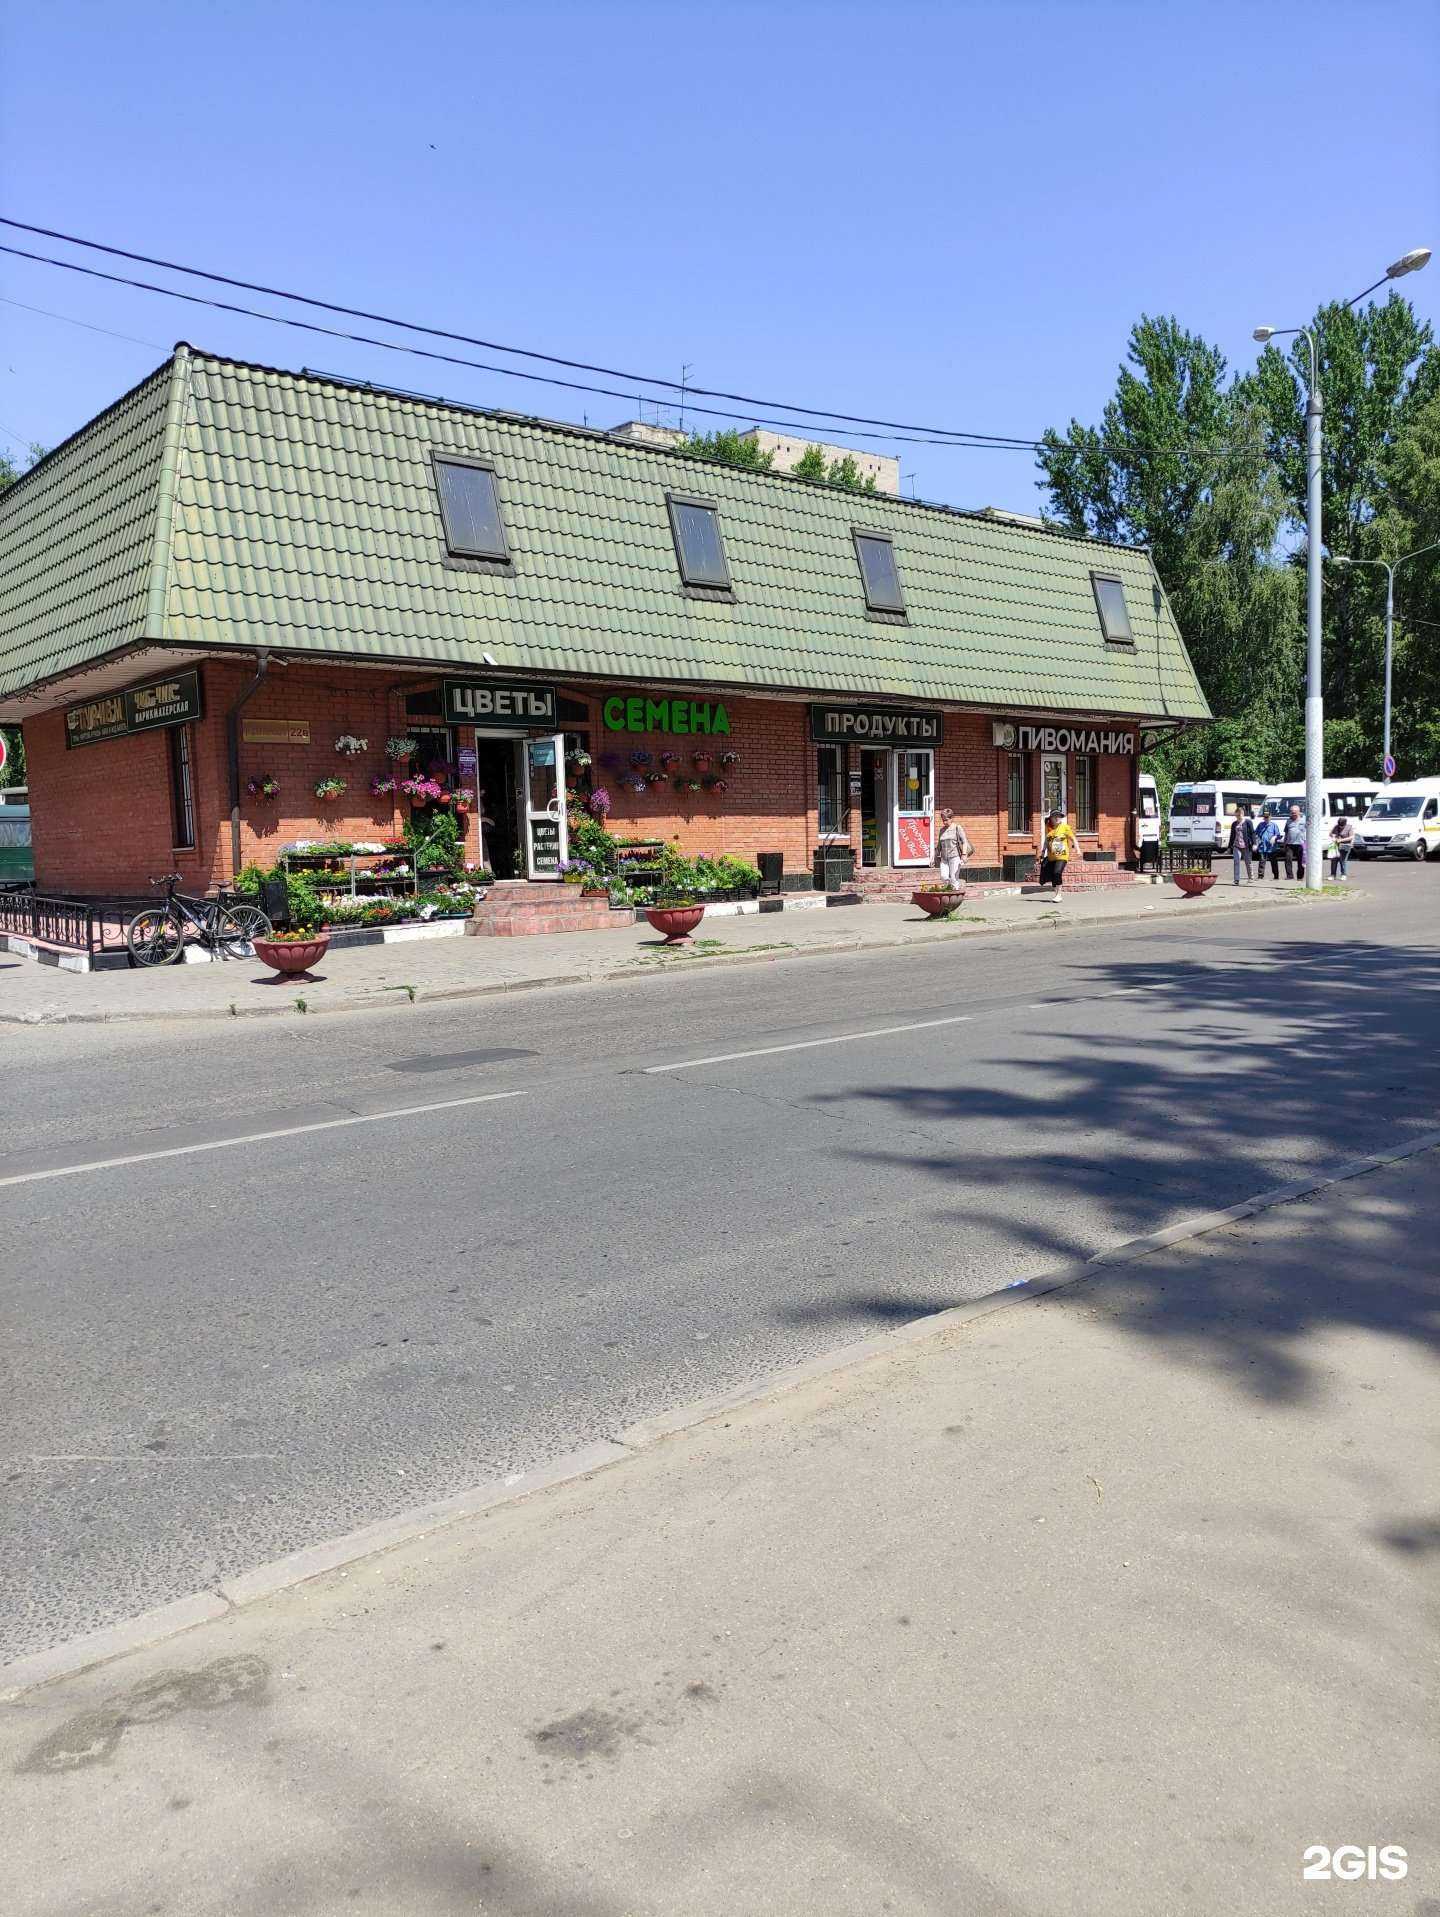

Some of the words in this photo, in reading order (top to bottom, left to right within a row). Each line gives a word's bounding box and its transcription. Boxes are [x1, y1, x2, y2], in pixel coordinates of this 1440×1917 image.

[135, 700, 189, 723] ПАРИКМАХЕРСКАЯ
[453, 689, 552, 718] ЦВЕТЫ
[603, 697, 730, 736] СЕМЕНА
[825, 712, 937, 738] ПРОДУКТЫ
[1018, 726, 1135, 755] ПИВОМАНИЯ
[536, 827, 556, 838] ЦВЕТЫ
[536, 856, 559, 865] СЕМЕНА
